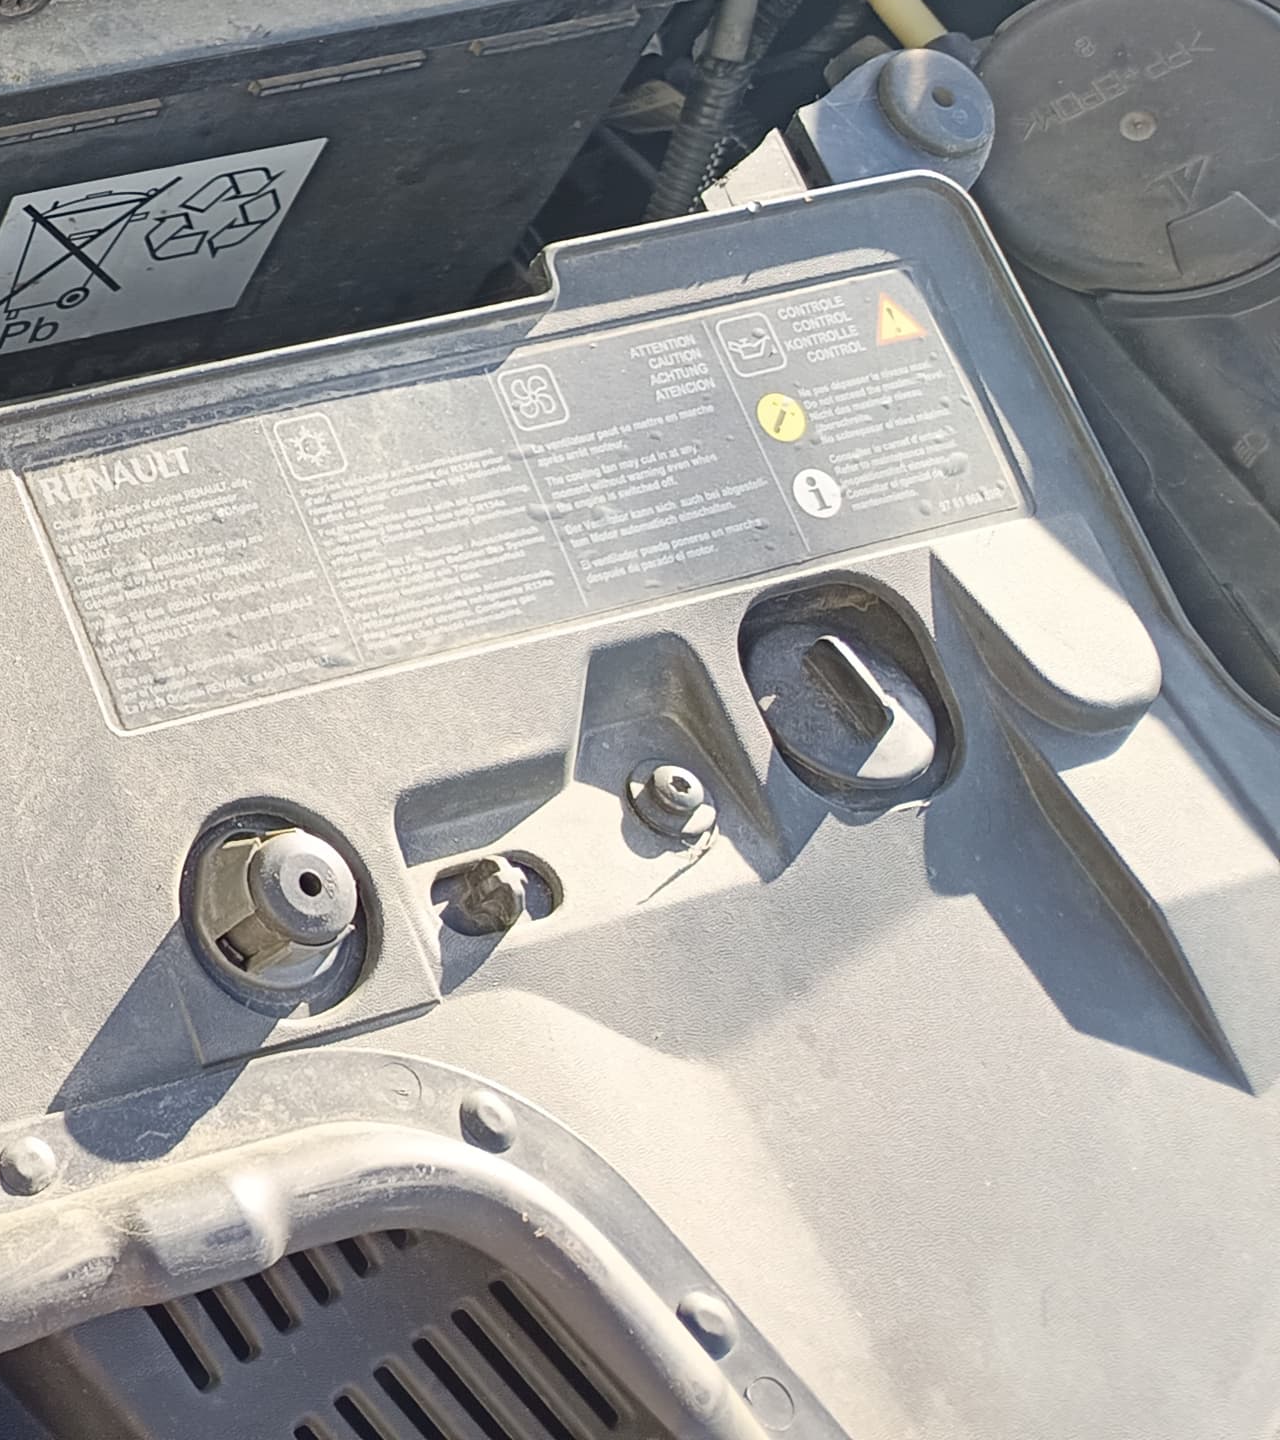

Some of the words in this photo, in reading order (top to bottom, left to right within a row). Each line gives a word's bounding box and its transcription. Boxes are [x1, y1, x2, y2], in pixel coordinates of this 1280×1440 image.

[777, 295, 845, 319] CONTROLE
[791, 310, 852, 332] CONTROL
[627, 334, 695, 358] ATTENTION
[784, 325, 858, 351] KONTROLLE
[648, 348, 702, 369] CAUTION
[806, 340, 866, 362] CONTROL
[647, 362, 708, 385] ACHTUNG
[653, 377, 716, 400] ATENCION
[596, 426, 619, 441] peut
[678, 404, 714, 419] marche
[39, 447, 190, 502] RENAULT
[545, 474, 563, 485] The
[564, 465, 601, 483] cooling
[601, 462, 616, 472] fan
[619, 459, 639, 470] may
[639, 453, 655, 463] cut
[656, 450, 667, 459] in
[668, 447, 678, 457] at
[680, 445, 697, 456] any
[590, 475, 625, 489] without
[627, 466, 665, 483] warning
[667, 462, 690, 471] even
[617, 481, 660, 498] switched
[655, 500, 675, 512] sich
[678, 493, 703, 507] auch
[639, 541, 671, 558] puede
[671, 533, 711, 550] ponerse
[711, 530, 723, 538] en
[725, 518, 762, 535] marcha
[641, 554, 675, 571] parado
[675, 551, 685, 561] el
